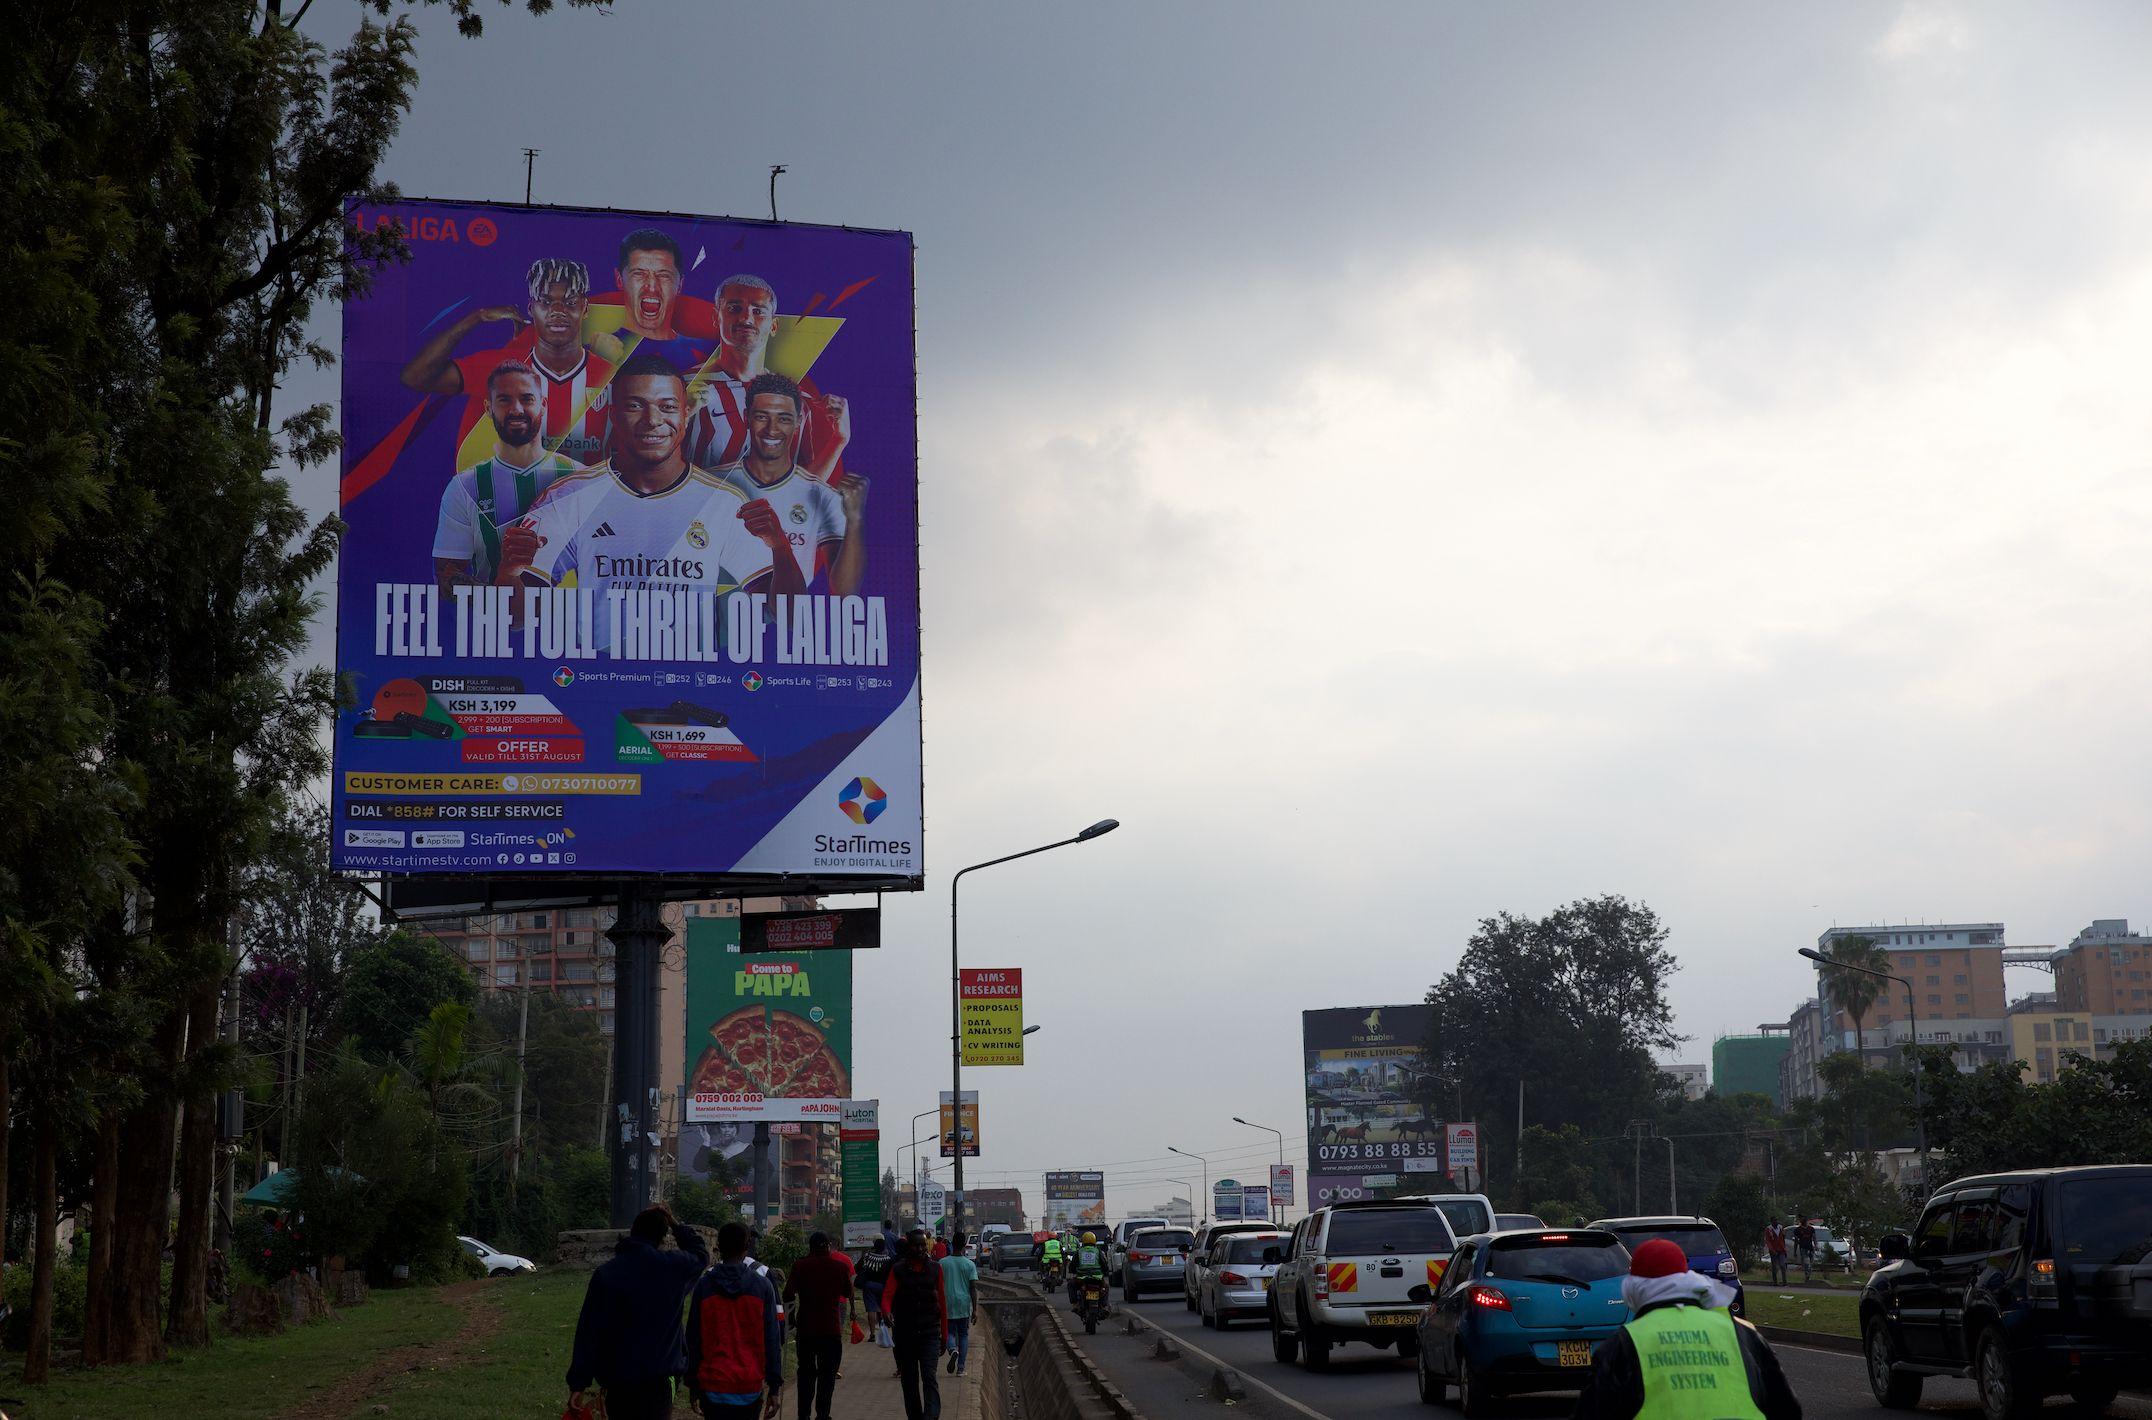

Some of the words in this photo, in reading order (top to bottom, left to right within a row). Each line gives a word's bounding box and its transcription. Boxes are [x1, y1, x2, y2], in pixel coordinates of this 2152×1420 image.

[594, 553, 704, 579] Emirates
[375, 583, 443, 657] FEEL
[452, 584, 514, 658] THE
[523, 586, 598, 660] FULL
[608, 588, 719, 663] THRILL
[727, 591, 767, 664] OF
[776, 593, 889, 667] LALIGA
[578, 671, 608, 682] Sports
[609, 672, 651, 682] Premium
[766, 676, 794, 687] Sports
[795, 677, 812, 686] Life
[431, 679, 465, 691] DISH
[448, 700, 476, 711] KSH
[480, 700, 517, 713] 3,199
[485, 716, 501, 724] 200
[649, 730, 673, 740] KSH
[676, 730, 706, 742] 1,699
[496, 740, 549, 753] OFFER
[618, 745, 653, 755] AERIAL
[350, 777, 444, 790] CUSTOMER
[449, 778, 499, 790] CARE:
[541, 778, 637, 790] 0730710077
[350, 804, 383, 817] DIAL
[438, 806, 467, 817] FOR
[470, 806, 501, 817] SELF
[504, 805, 563, 817] SERVICE
[362, 837, 387, 845] Google
[387, 837, 402, 846] Play
[470, 832, 535, 845] StarTimes
[546, 832, 565, 844] ON
[814, 834, 911, 855] StarTimes
[344, 854, 492, 866] www.startimestv.com
[814, 857, 846, 867] ENJOY
[848, 858, 888, 867] DIGITAL
[890, 859, 911, 868] LIFE
[814, 930, 834, 941] 005
[751, 964, 781, 974] Come
[781, 964, 793, 974] to
[735, 970, 811, 996] PAPA
[976, 973, 1006, 982] AIMS
[963, 985, 1018, 995] RESEARCH
[966, 1004, 1019, 1012] PROPOSALS
[967, 1027, 1012, 1035] ANALYSIS
[1352, 1034, 1364, 1042] the
[1365, 1033, 1395, 1042] stables
[1344, 1050, 1368, 1058] FINE
[1369, 1048, 1403, 1057] LIVING
[695, 1094, 720, 1103] 0759
[722, 1094, 741, 1103] 002
[743, 1094, 763, 1103] 003
[819, 1103, 840, 1112] JOHN
[844, 1108, 875, 1120] Luton
[1319, 1145, 1358, 1160] 0793
[1364, 1143, 1385, 1158] 88
[1390, 1142, 1411, 1157] 88
[1416, 1142, 1437, 1156] 55
[1318, 1185, 1362, 1200] odoo
[1657, 1329, 1711, 1345] KEMUMA
[1647, 1351, 1730, 1368] ENGINEERING
[1669, 1373, 1718, 1390] SYSTEM
